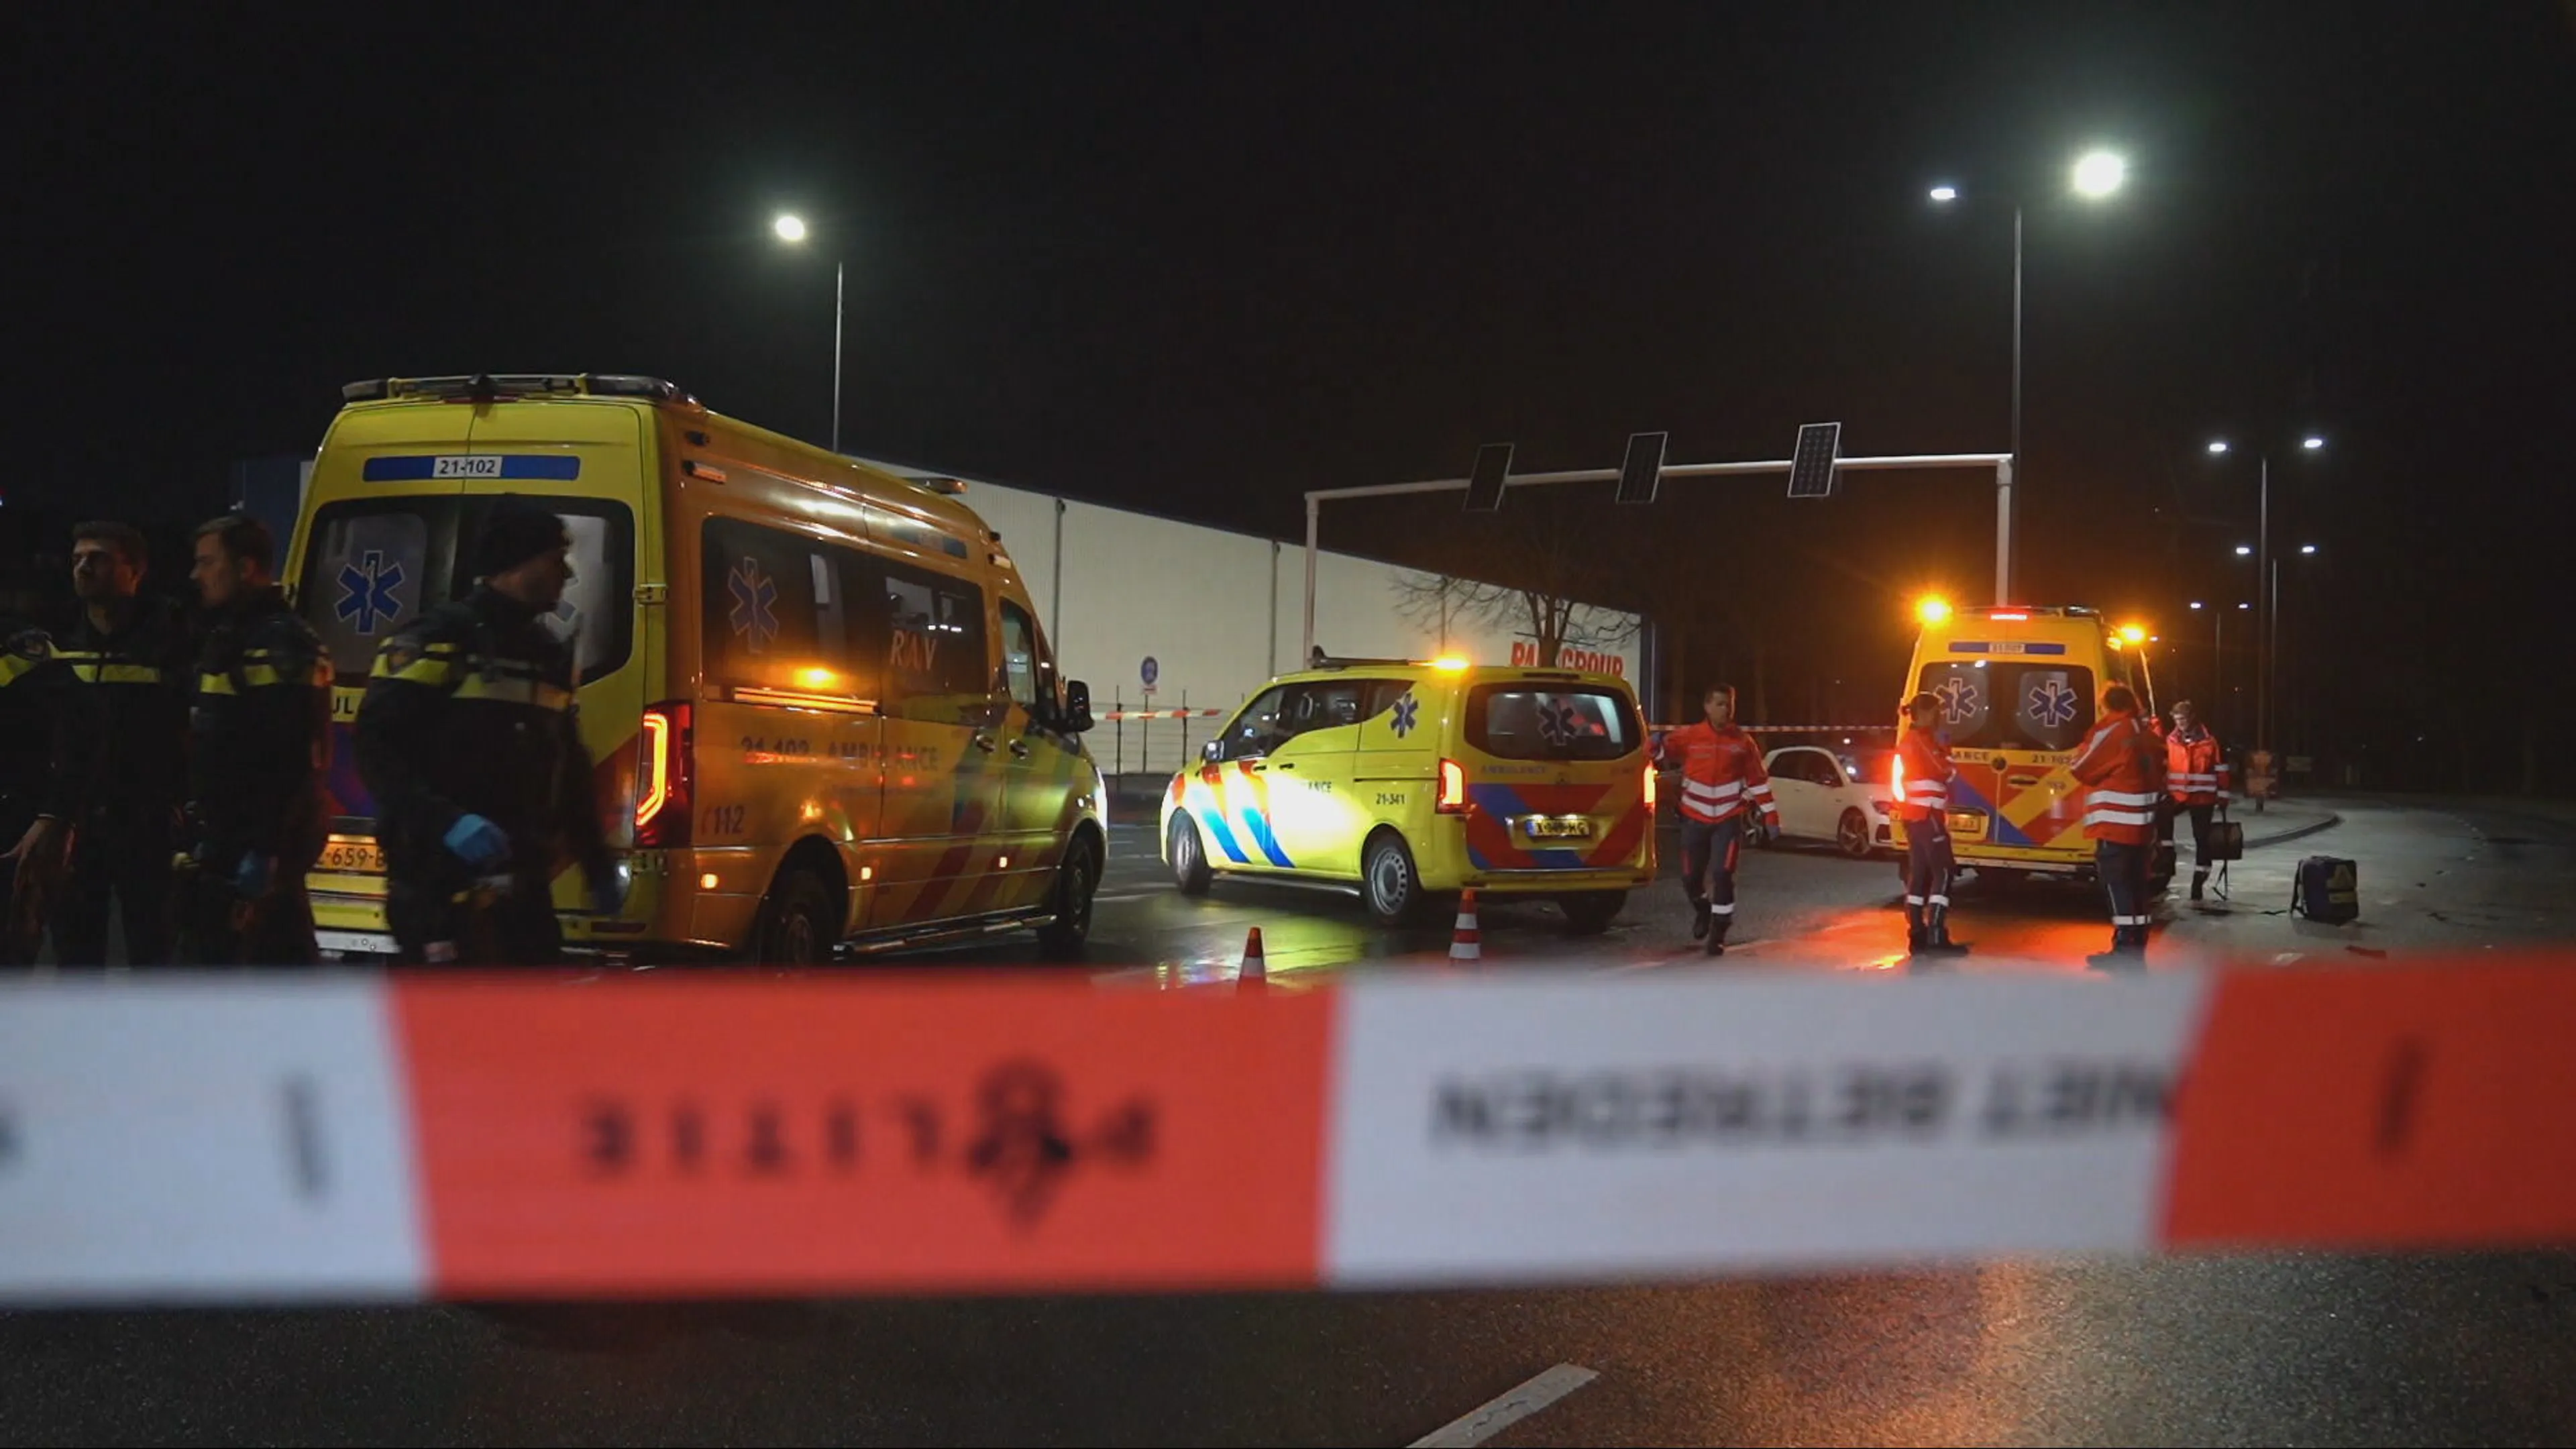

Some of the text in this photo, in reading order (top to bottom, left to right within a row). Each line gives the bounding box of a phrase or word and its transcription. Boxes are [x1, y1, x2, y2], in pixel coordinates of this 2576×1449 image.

[439, 460, 495, 474] 21-102
[890, 630, 936, 672] RAV
[1377, 793, 1405, 805] 21-341
[1429, 1065, 1951, 1155] BETREDEN
